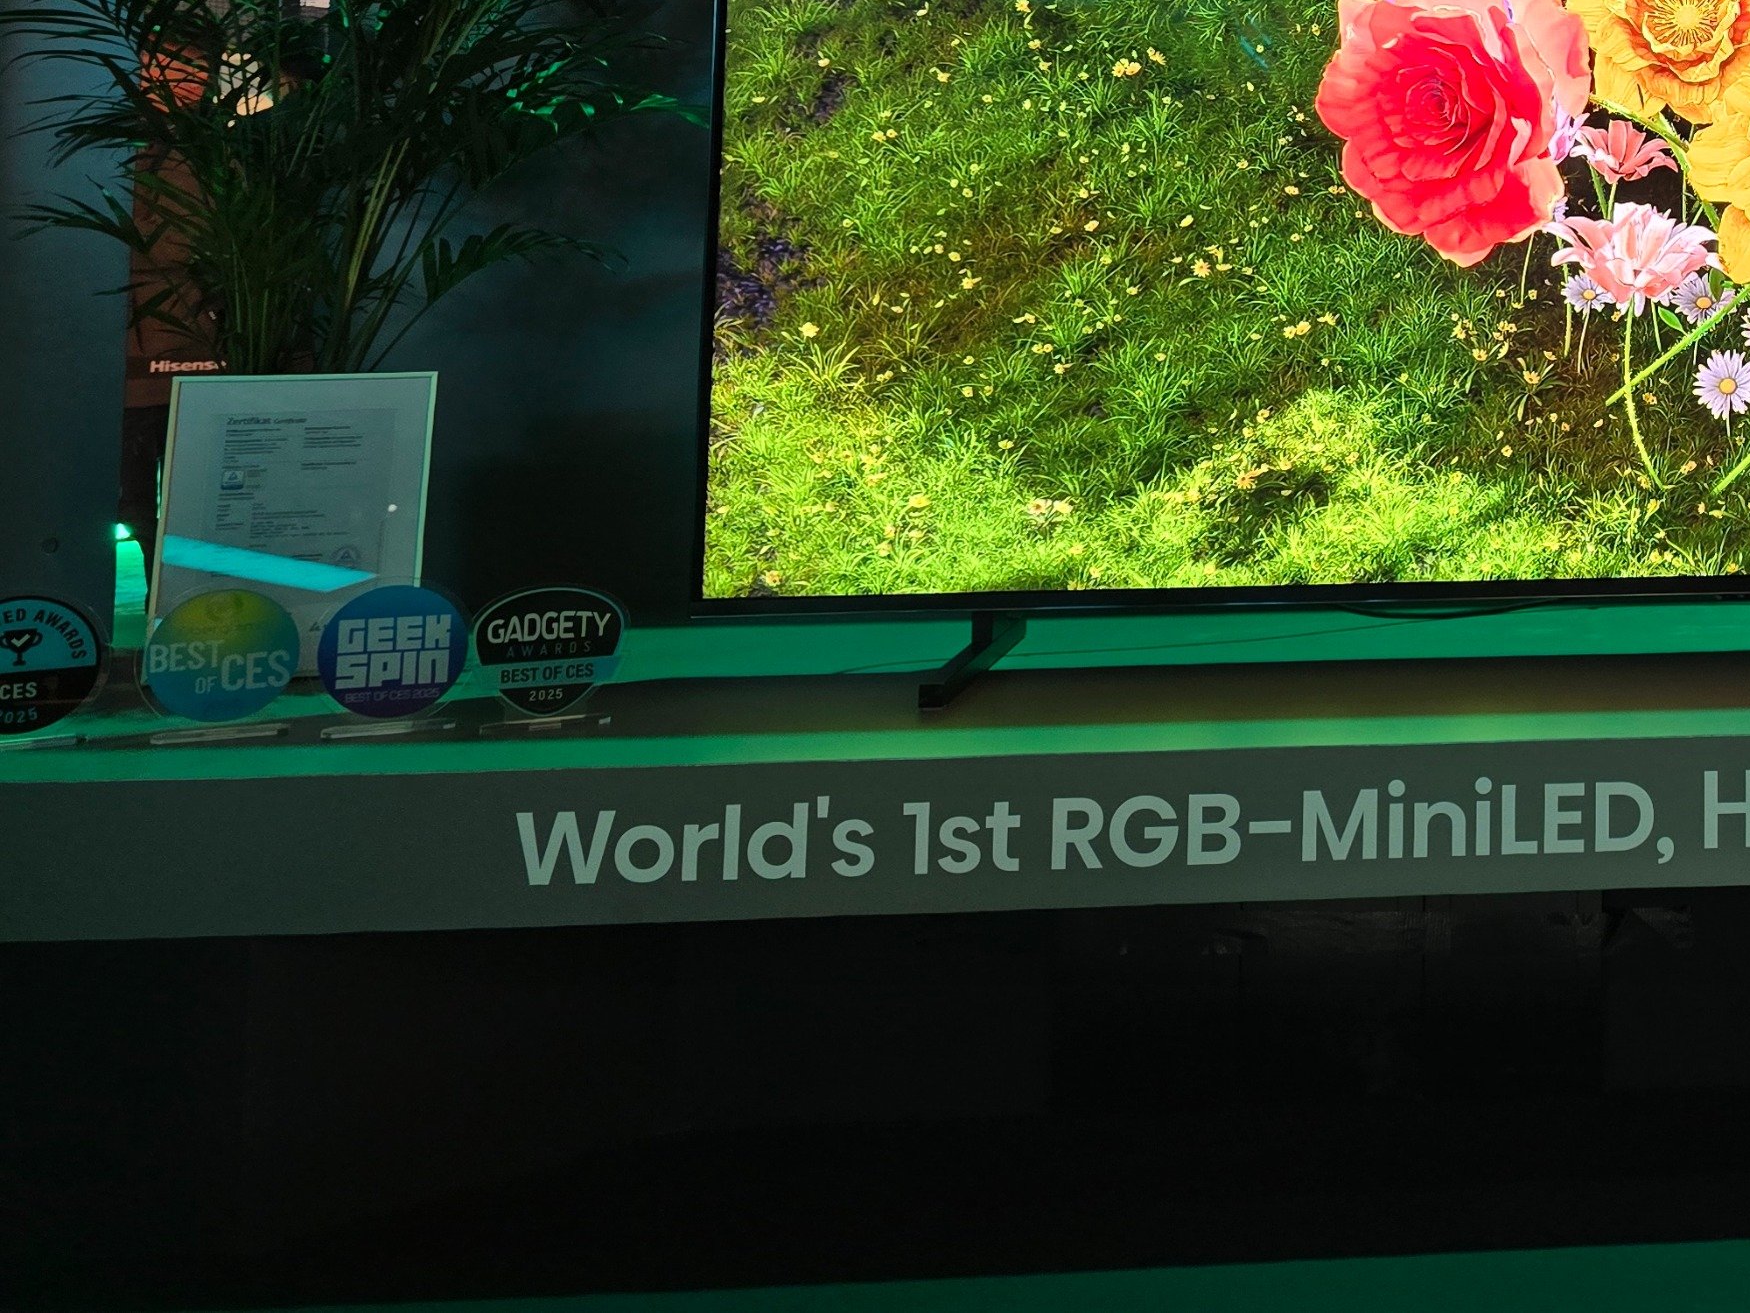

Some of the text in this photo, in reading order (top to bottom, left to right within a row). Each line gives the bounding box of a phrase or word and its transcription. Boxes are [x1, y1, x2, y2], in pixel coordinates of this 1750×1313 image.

[33, 609, 87, 660] AWARDS
[337, 613, 452, 654] GEEK
[486, 610, 612, 645] GADGETY
[150, 639, 224, 673] BEST
[506, 640, 592, 658] AWARDS
[194, 675, 217, 696] OF
[220, 649, 292, 693] CES
[334, 649, 451, 691] SPIN
[500, 662, 594, 684] BEST OF CES
[0, 681, 38, 700] CES
[528, 687, 564, 703] 2025
[516, 795, 875, 886] World's
[903, 801, 1021, 875] 1st
